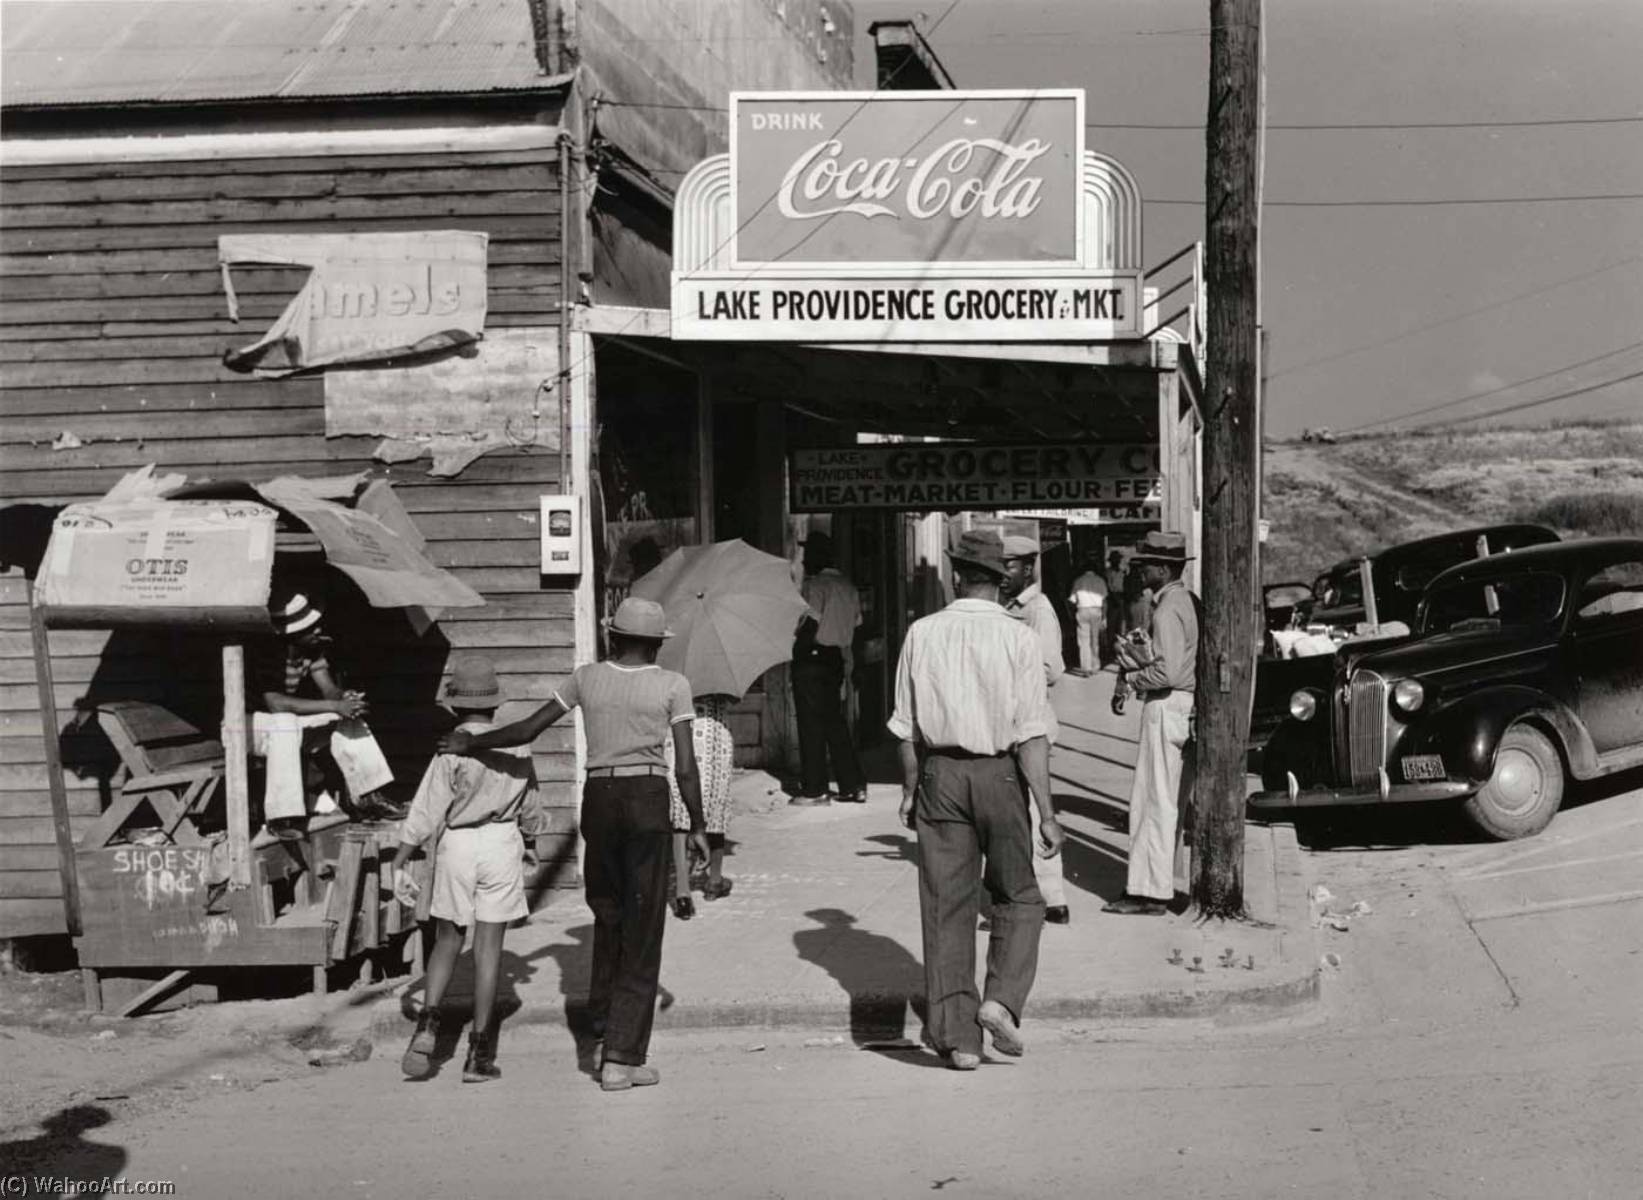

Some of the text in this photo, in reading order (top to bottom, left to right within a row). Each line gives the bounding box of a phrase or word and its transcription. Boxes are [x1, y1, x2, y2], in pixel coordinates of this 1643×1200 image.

[751, 112, 824, 131] DRINK
[777, 138, 1052, 220] Coca-Cola
[698, 290, 761, 320] LAKE
[772, 289, 936, 320] PROVIDENCE
[944, 289, 1058, 320] GROCERY
[1073, 289, 1125, 321] MKT.
[799, 467, 881, 481] PROVIDENCE
[886, 446, 1105, 480] GROCERY
[125, 558, 189, 576] OTIS
